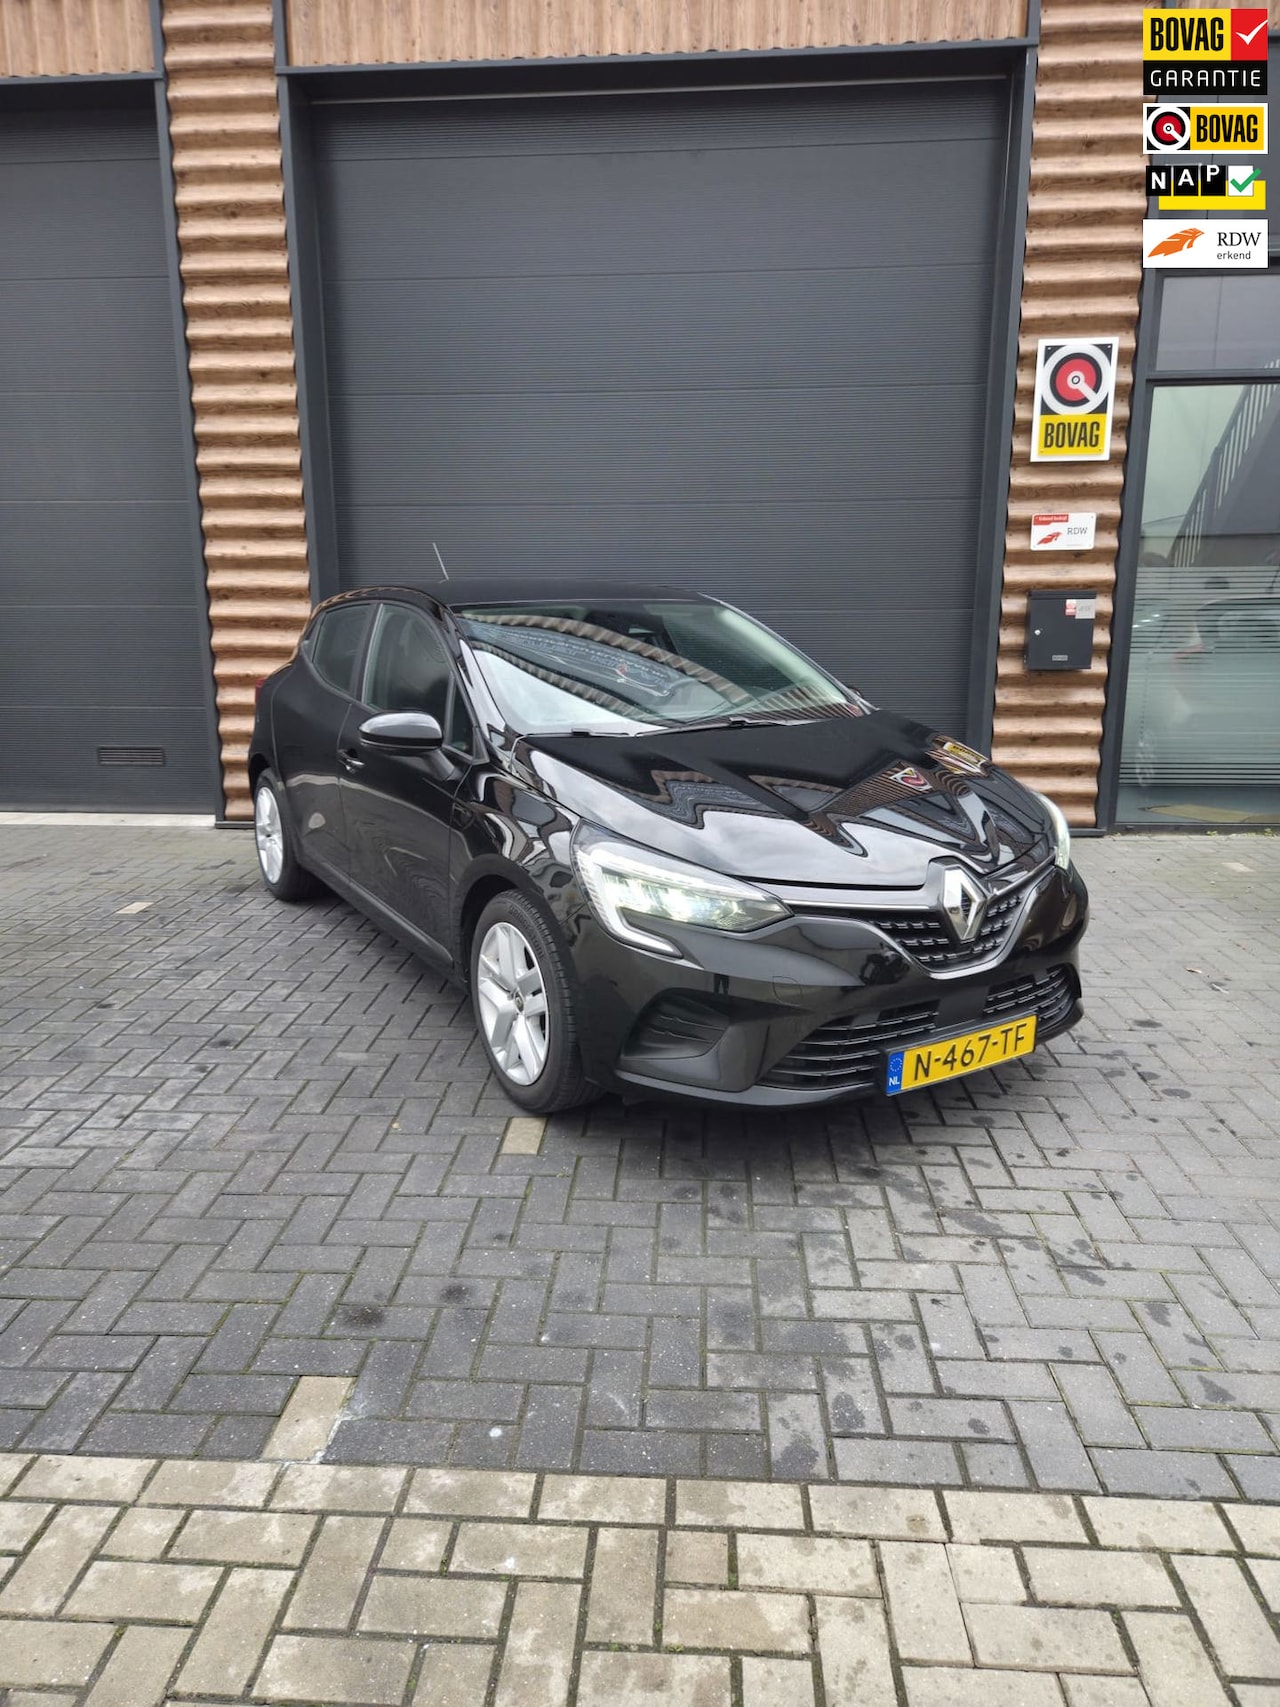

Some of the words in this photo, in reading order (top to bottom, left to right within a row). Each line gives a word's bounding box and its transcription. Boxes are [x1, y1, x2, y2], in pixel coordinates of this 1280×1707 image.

[1043, 421, 1101, 448] BOVAG
[1066, 527, 1088, 536] RDW
[914, 1023, 1027, 1081] N-467-TF
[888, 1075, 900, 1086] NL
